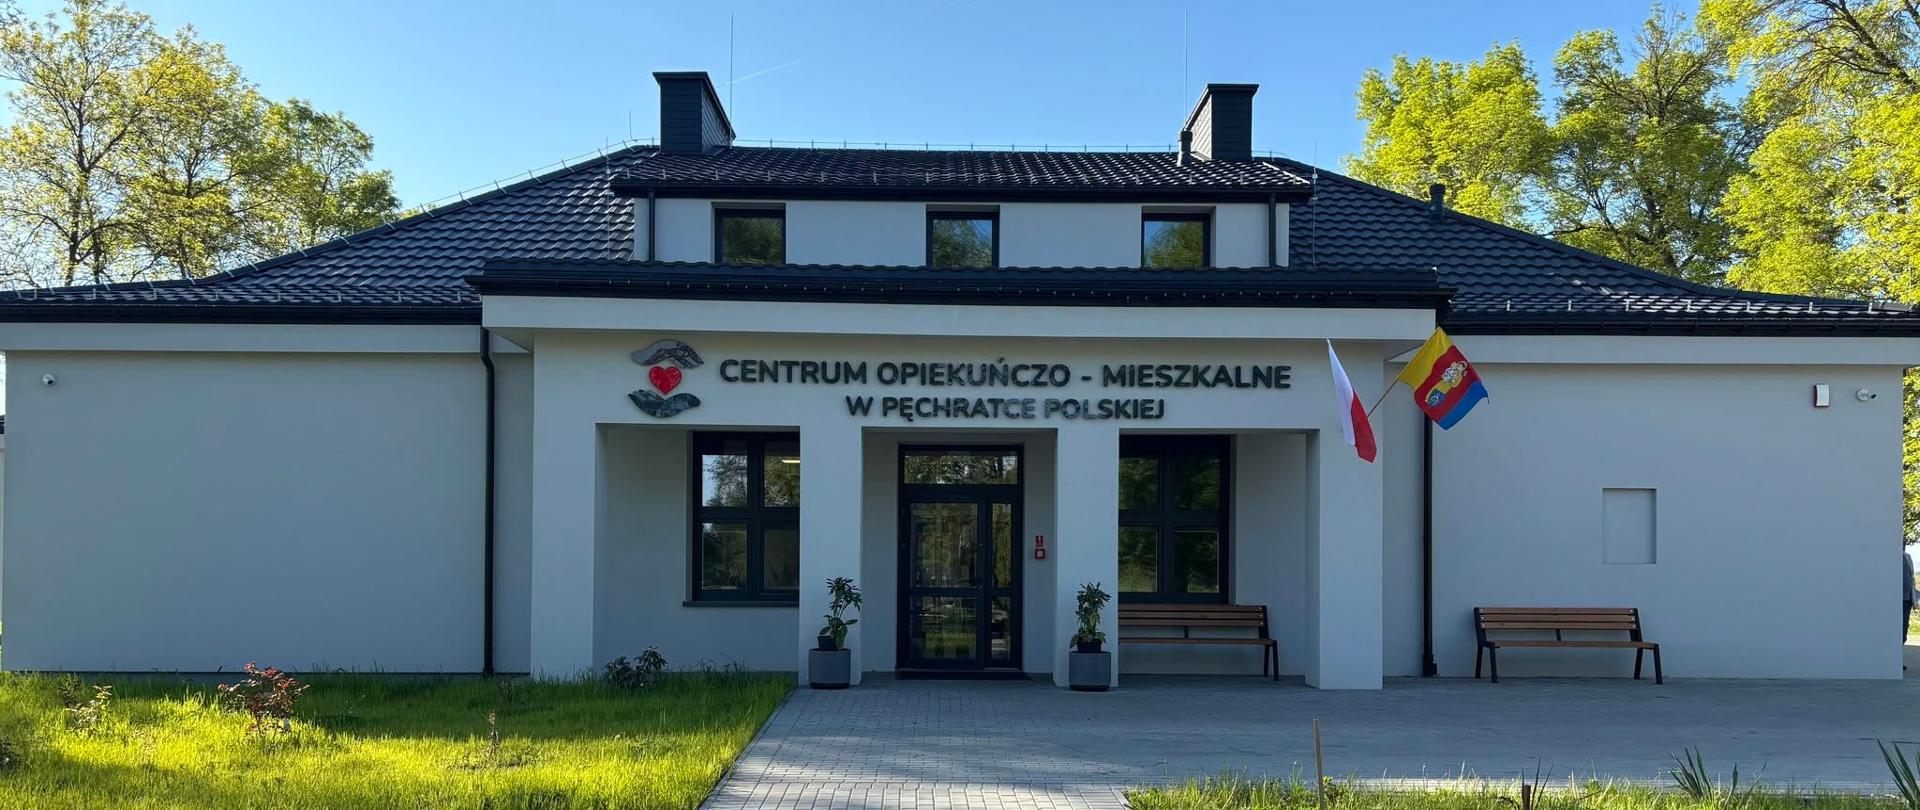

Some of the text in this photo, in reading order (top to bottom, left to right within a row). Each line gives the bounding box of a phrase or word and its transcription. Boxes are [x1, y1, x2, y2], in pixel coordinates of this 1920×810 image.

[719, 359, 868, 384] CENTRUM
[876, 357, 1071, 387] OPIEKUŃCZO
[1102, 364, 1292, 389] MIESZKALNE
[845, 395, 1165, 423] W PĘCHRATCE POLSKIEJ
